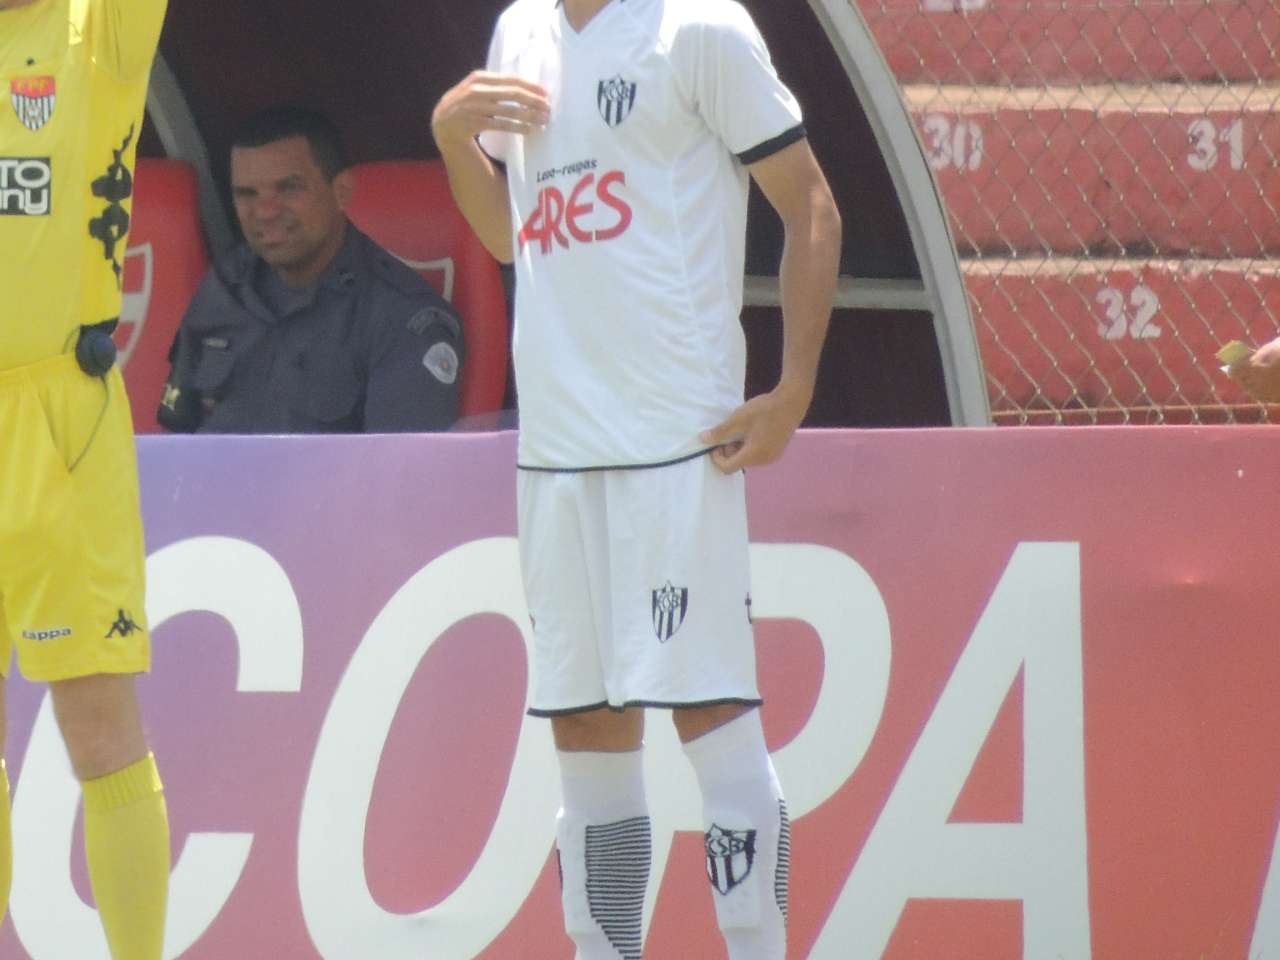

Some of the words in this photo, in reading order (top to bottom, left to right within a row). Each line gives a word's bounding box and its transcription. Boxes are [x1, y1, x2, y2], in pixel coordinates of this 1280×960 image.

[924, 114, 983, 171] 30
[1187, 118, 1244, 171] 31
[518, 169, 633, 255] ARES
[1096, 285, 1161, 340] 32
[9, 536, 1092, 960] COPA
